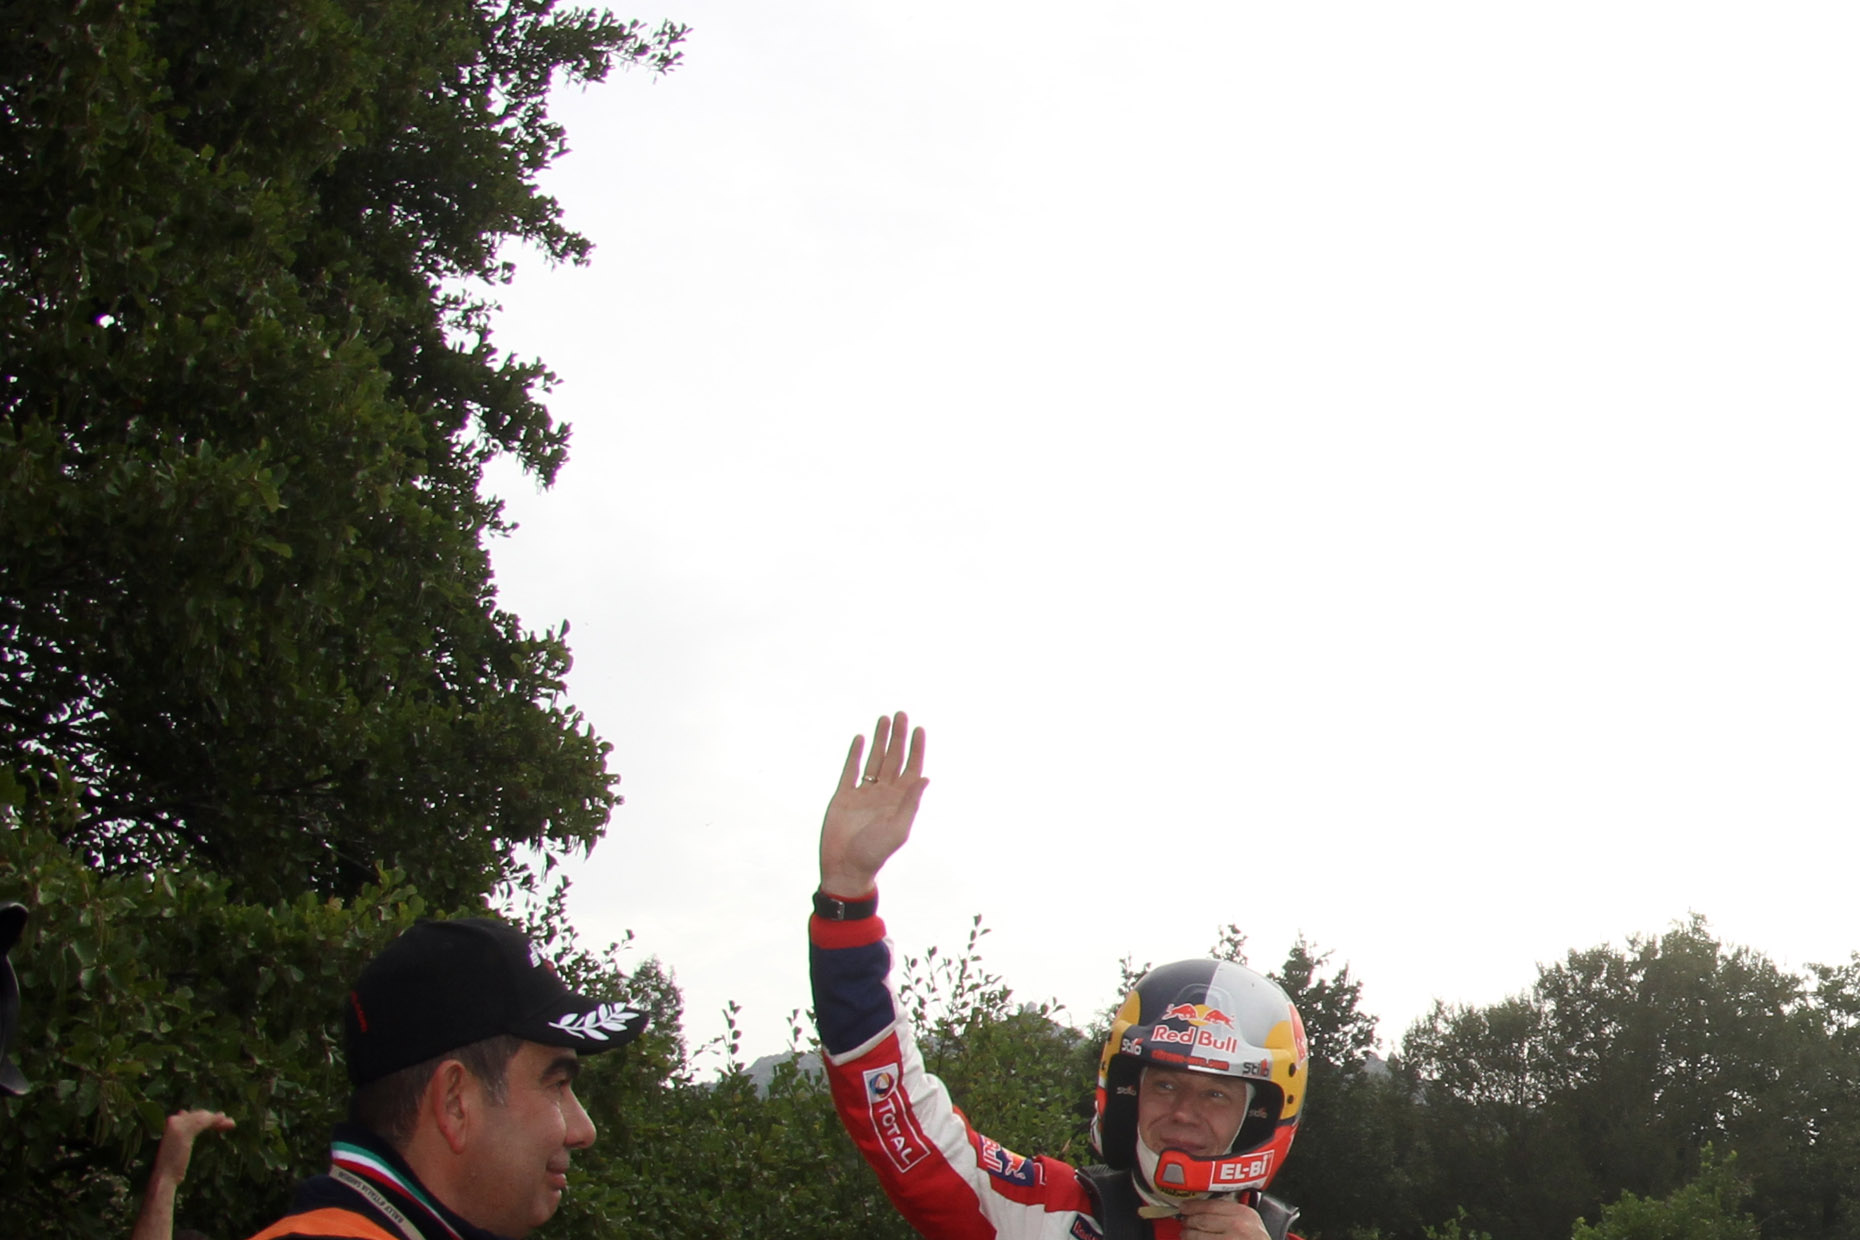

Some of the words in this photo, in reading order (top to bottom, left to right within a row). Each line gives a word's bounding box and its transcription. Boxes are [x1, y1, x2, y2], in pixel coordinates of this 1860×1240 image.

[1152, 1024, 1195, 1044] Red
[1197, 1030, 1237, 1053] Bull
[878, 1098, 912, 1164] TOTAL
